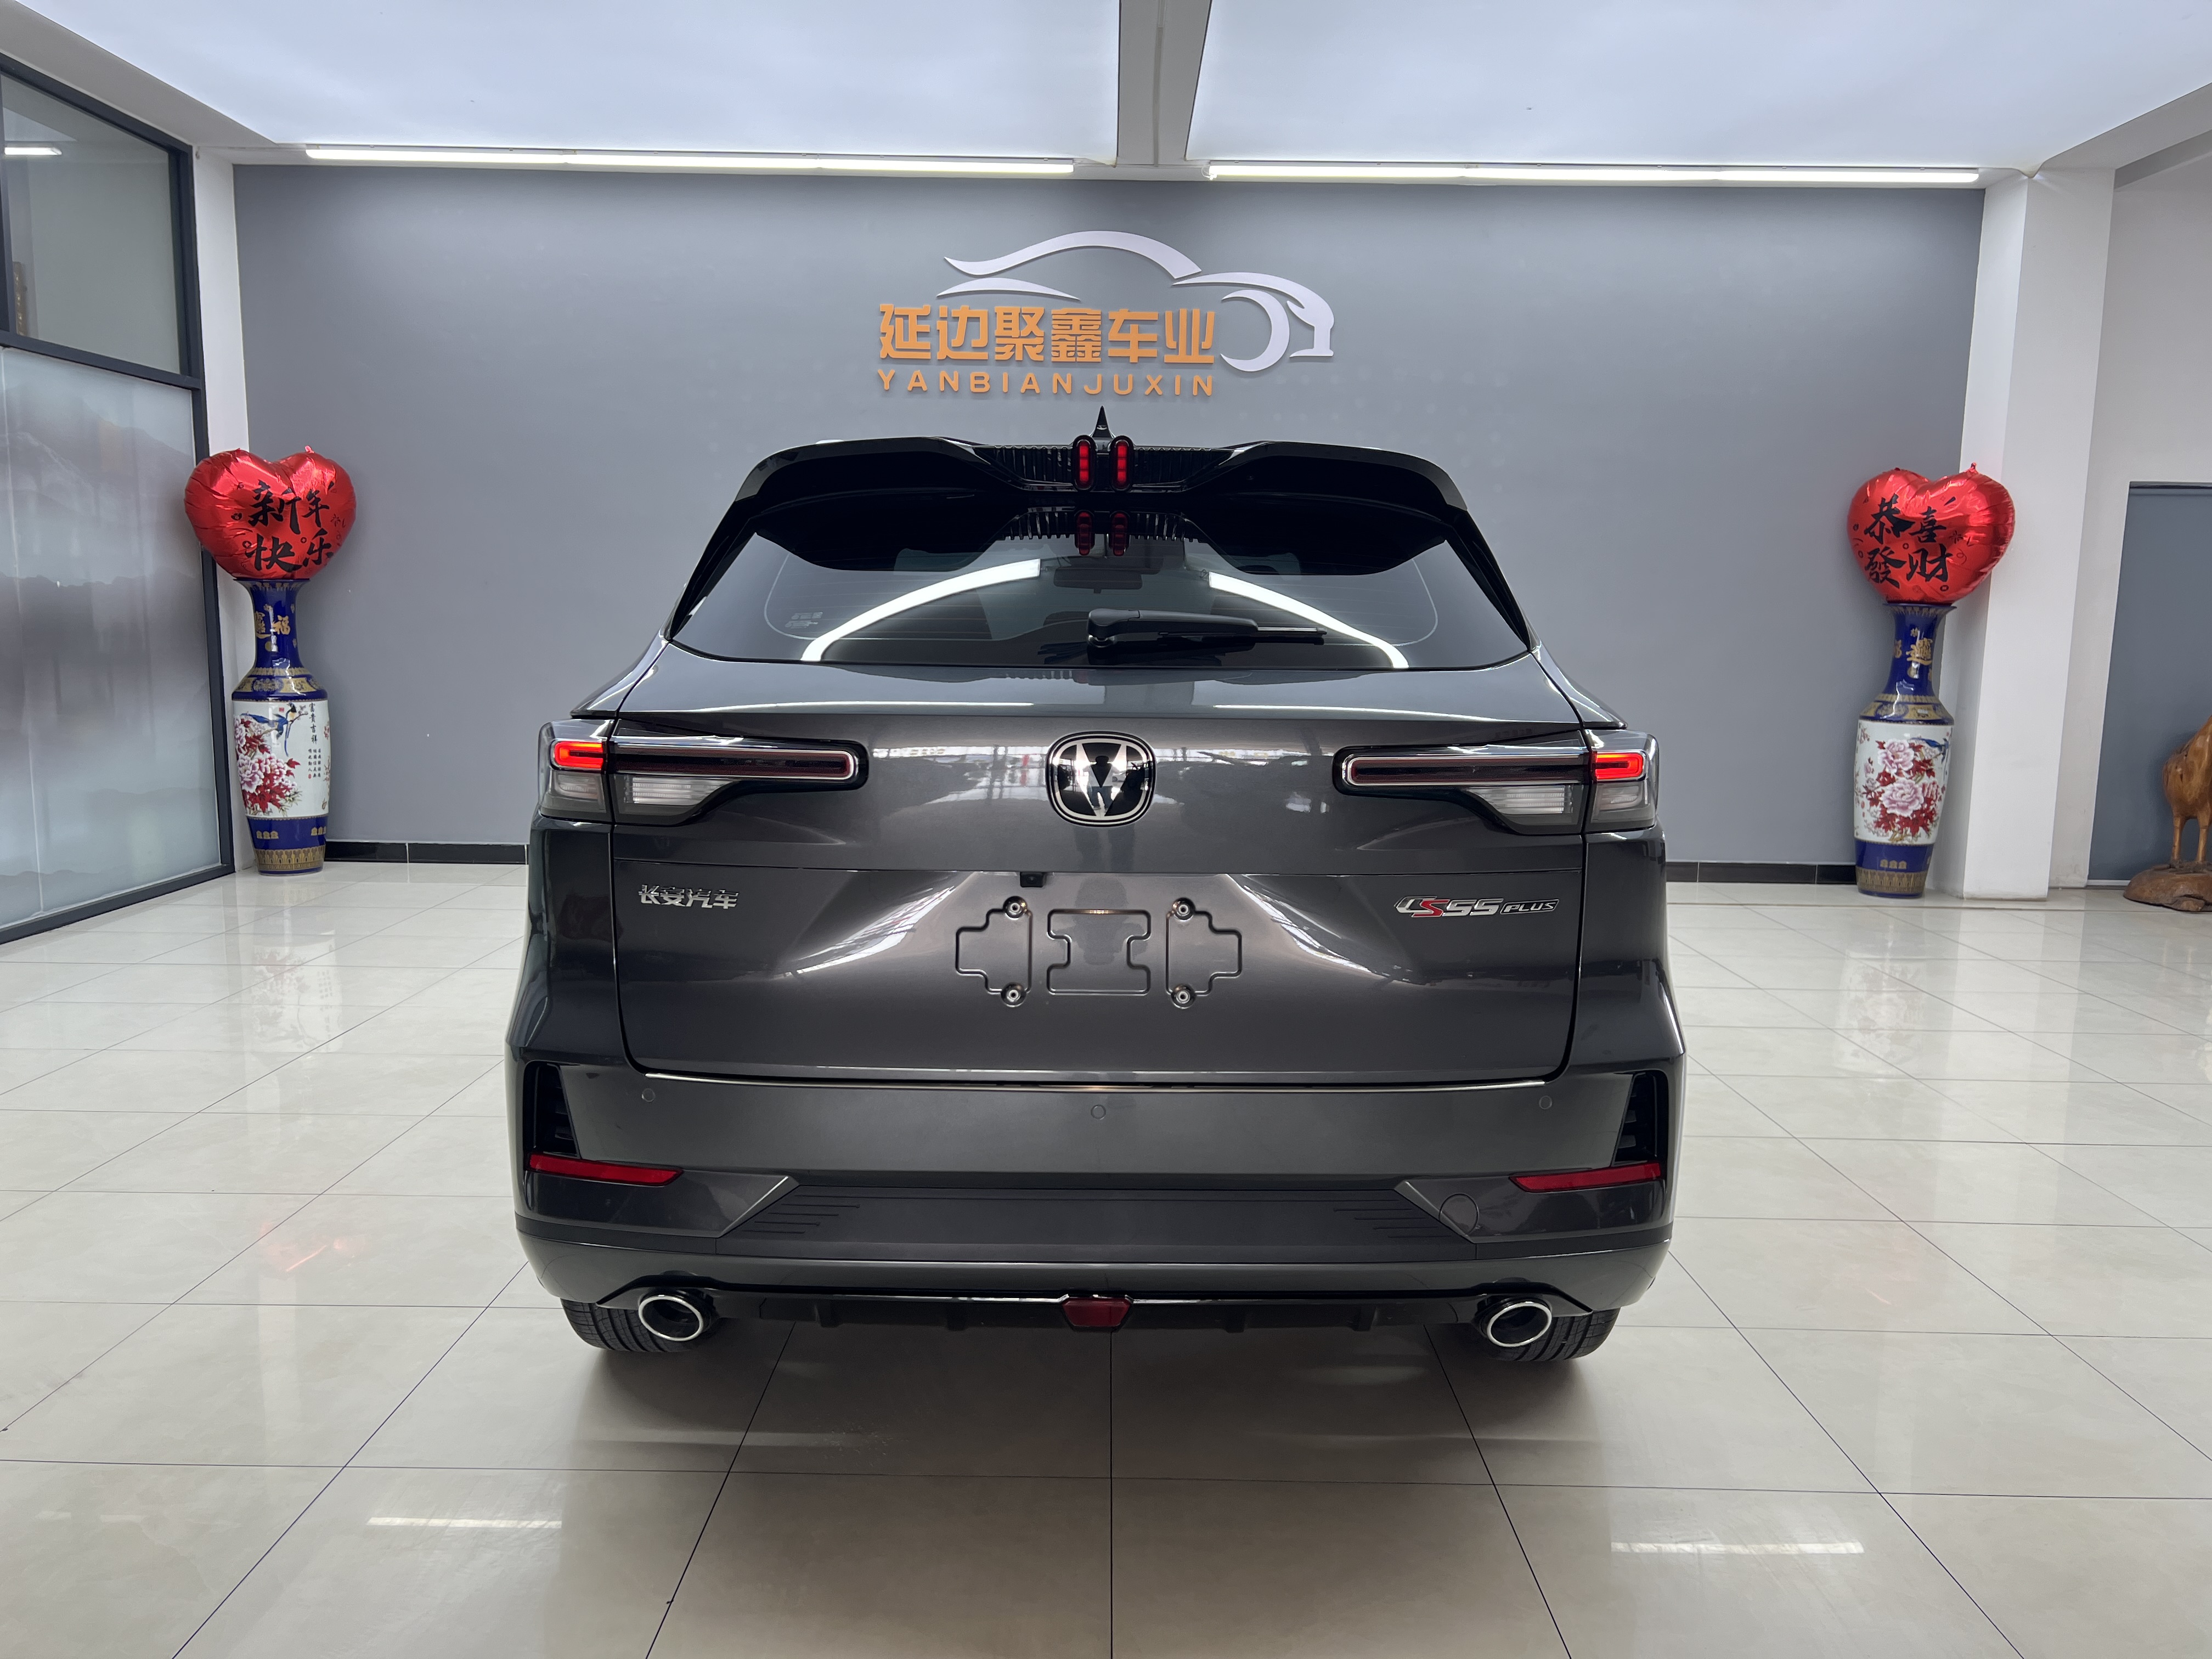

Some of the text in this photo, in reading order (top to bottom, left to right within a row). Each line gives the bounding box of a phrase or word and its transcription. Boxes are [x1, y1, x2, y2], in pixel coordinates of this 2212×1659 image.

[880, 304, 1215, 363] 延边聚鑫车业
[878, 370, 1213, 396] YANBIANJUXIN
[1864, 493, 1946, 544] 恭喜
[245, 528, 334, 573] 快乐
[638, 884, 738, 909] 长安汽车
[1504, 903, 1554, 913] PLUS
